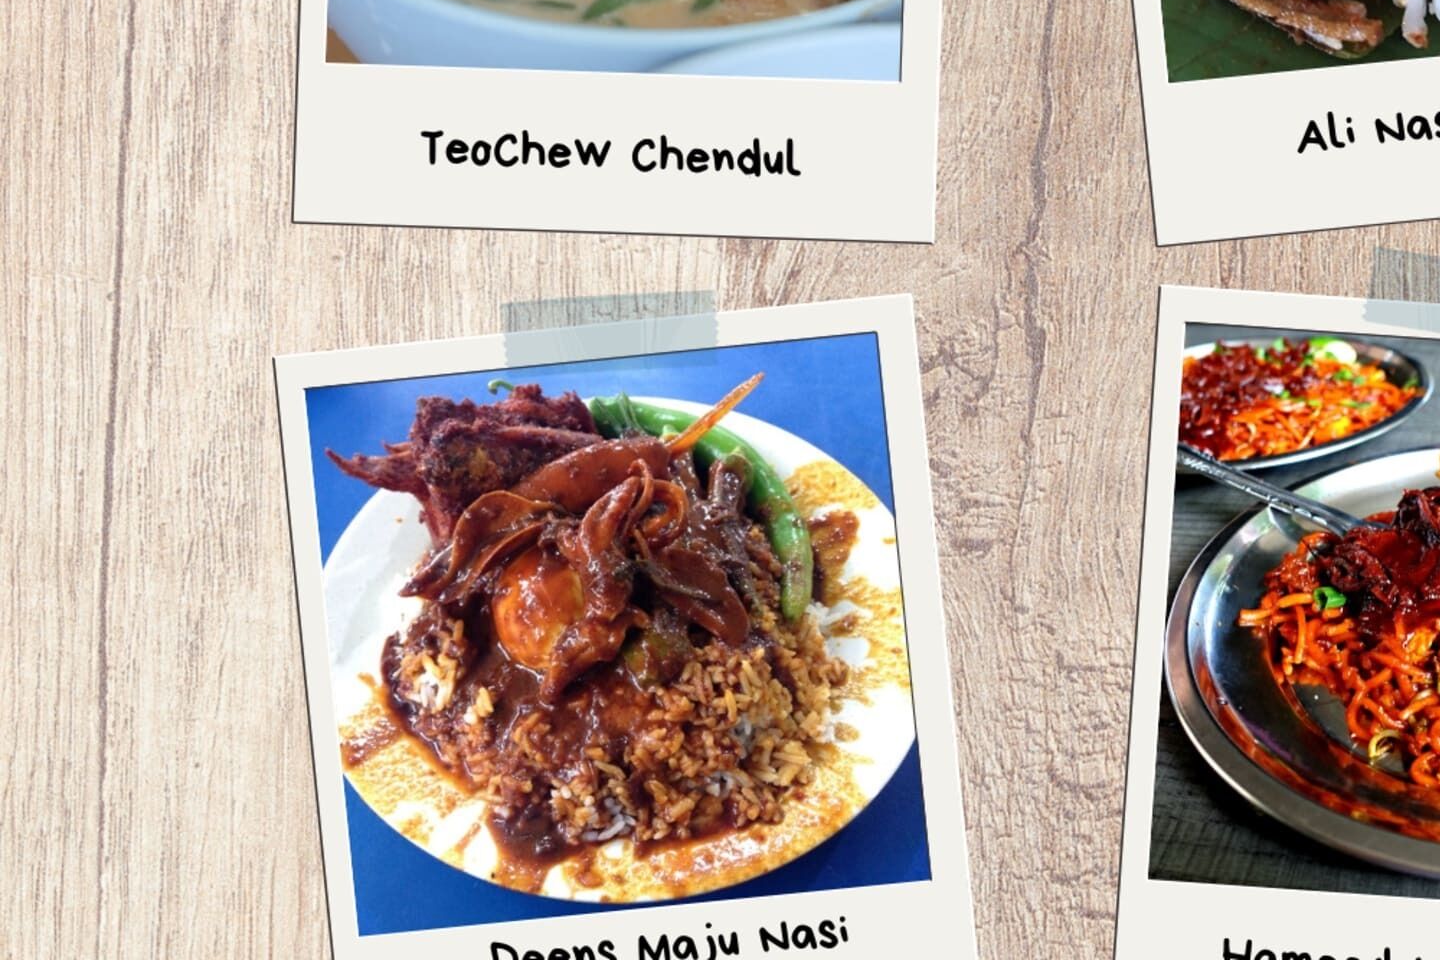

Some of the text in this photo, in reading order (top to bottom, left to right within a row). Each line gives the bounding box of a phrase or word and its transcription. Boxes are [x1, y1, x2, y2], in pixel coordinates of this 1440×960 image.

[420, 129, 803, 178] TeoChew Chendul
[1297, 109, 1355, 154] Ali
[637, 922, 740, 960] Maju
[758, 915, 849, 953] Nasi
